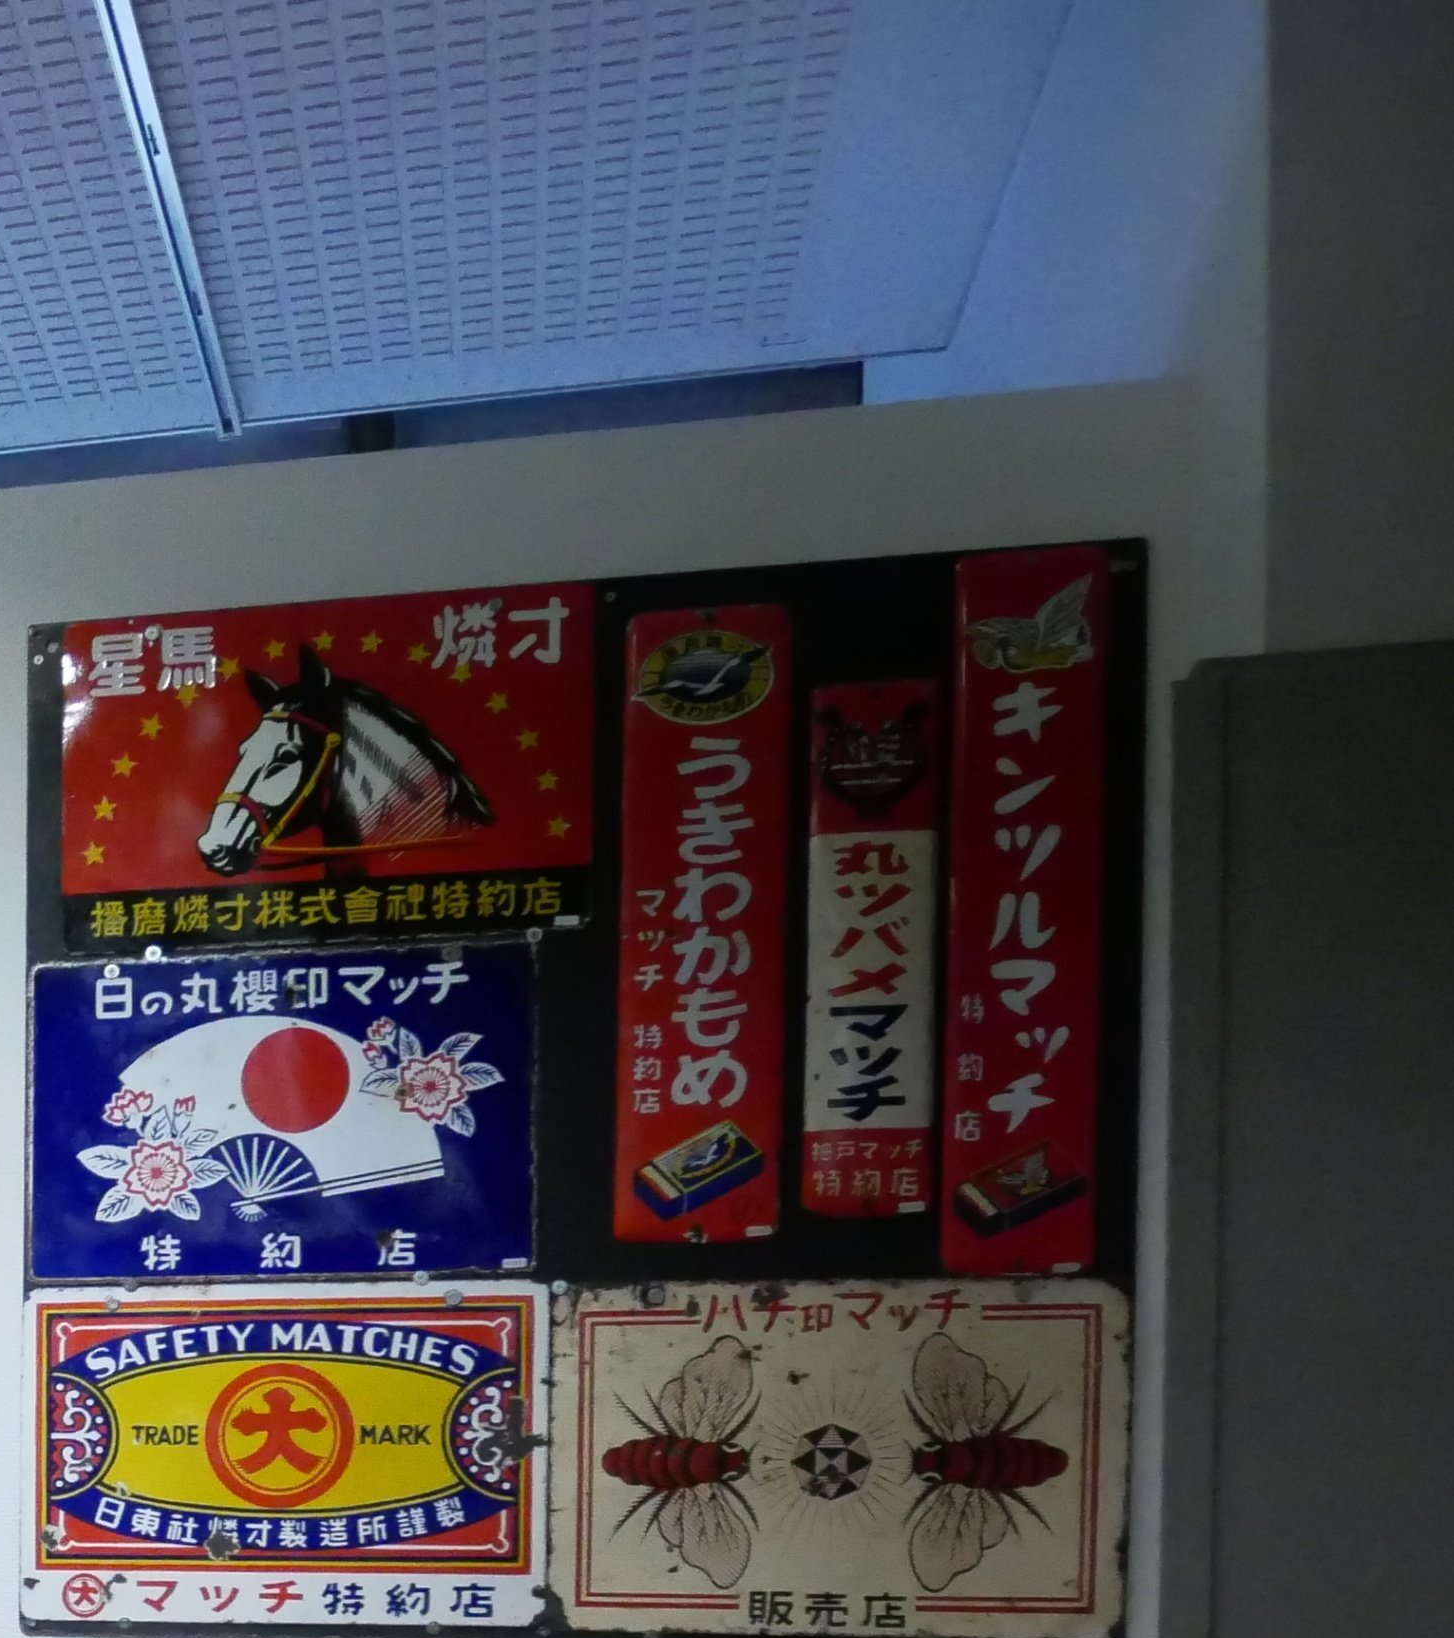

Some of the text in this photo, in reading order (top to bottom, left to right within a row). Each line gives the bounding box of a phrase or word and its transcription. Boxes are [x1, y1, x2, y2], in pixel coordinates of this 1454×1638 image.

[88, 625, 218, 698] 星馬
[670, 736, 756, 1109] うきわかもめ
[987, 681, 1071, 1135] キンツルマッチ
[952, 993, 985, 1143] 特約店
[810, 1166, 920, 1199] 特約店
[140, 1229, 417, 1272] 特約店
[701, 1289, 972, 1334] ハチ印マッチ
[84, 1321, 480, 1381] SAFETY MATCHES
[130, 1424, 431, 1447] TRADE MARK
[230, 1386, 330, 1476] 大
[747, 1591, 909, 1629] 販売店
